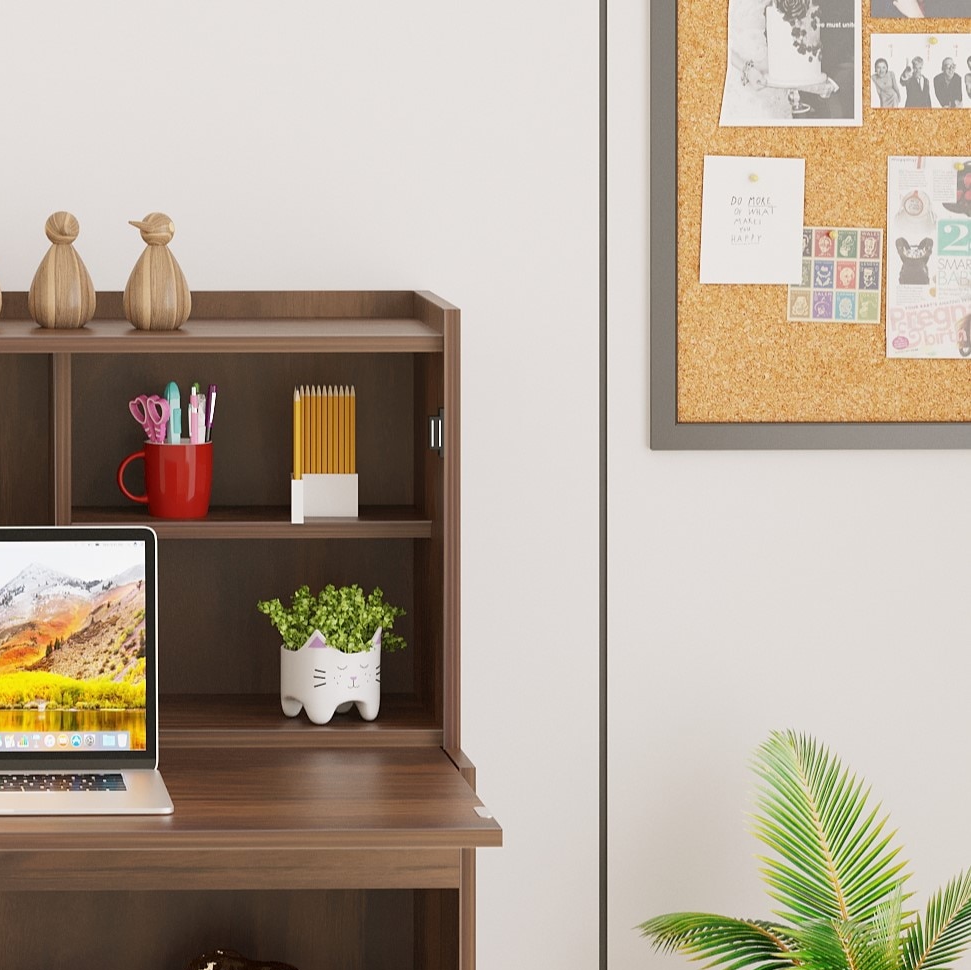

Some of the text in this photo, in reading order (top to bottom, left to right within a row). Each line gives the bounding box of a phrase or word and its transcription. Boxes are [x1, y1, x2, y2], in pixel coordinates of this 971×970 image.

[730, 196, 771, 206] DO MORE
[748, 206, 774, 216] WHAT
[730, 233, 763, 243] HAPPY
